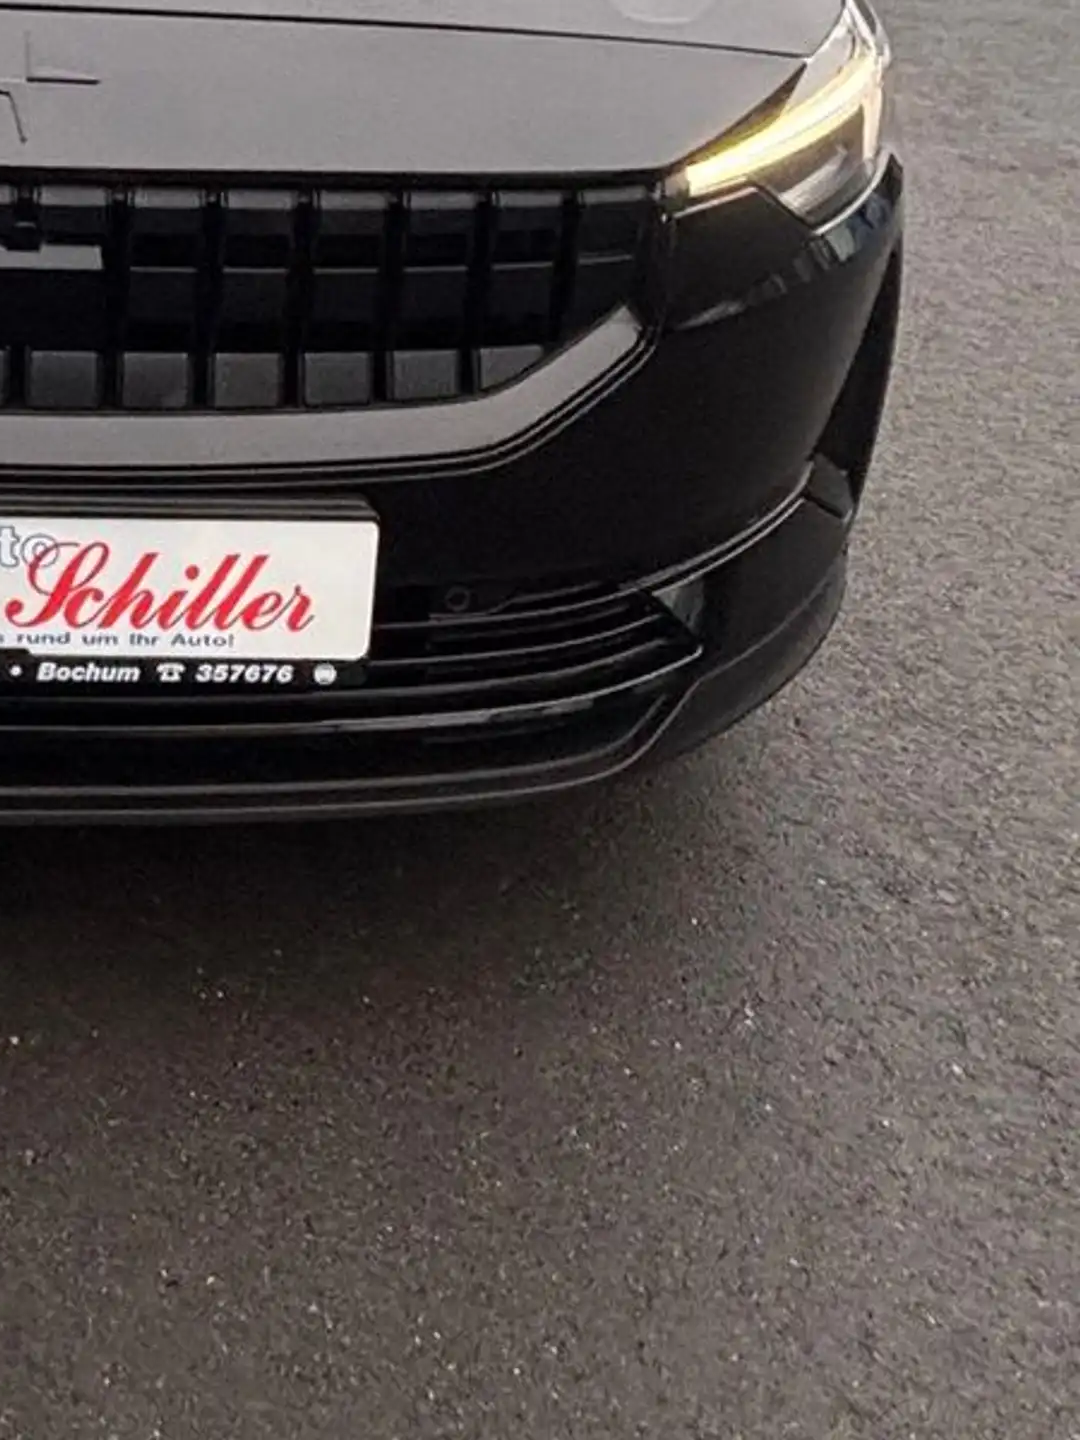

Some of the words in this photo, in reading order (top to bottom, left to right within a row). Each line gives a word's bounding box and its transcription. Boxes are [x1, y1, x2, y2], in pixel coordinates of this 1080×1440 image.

[4, 541, 315, 632] Schiller
[17, 632, 71, 646] rund
[82, 635, 119, 647] um
[129, 632, 159, 647] Ihr
[171, 633, 235, 648] Auto!
[37, 663, 141, 683] Bochum
[195, 665, 294, 683] 357676
